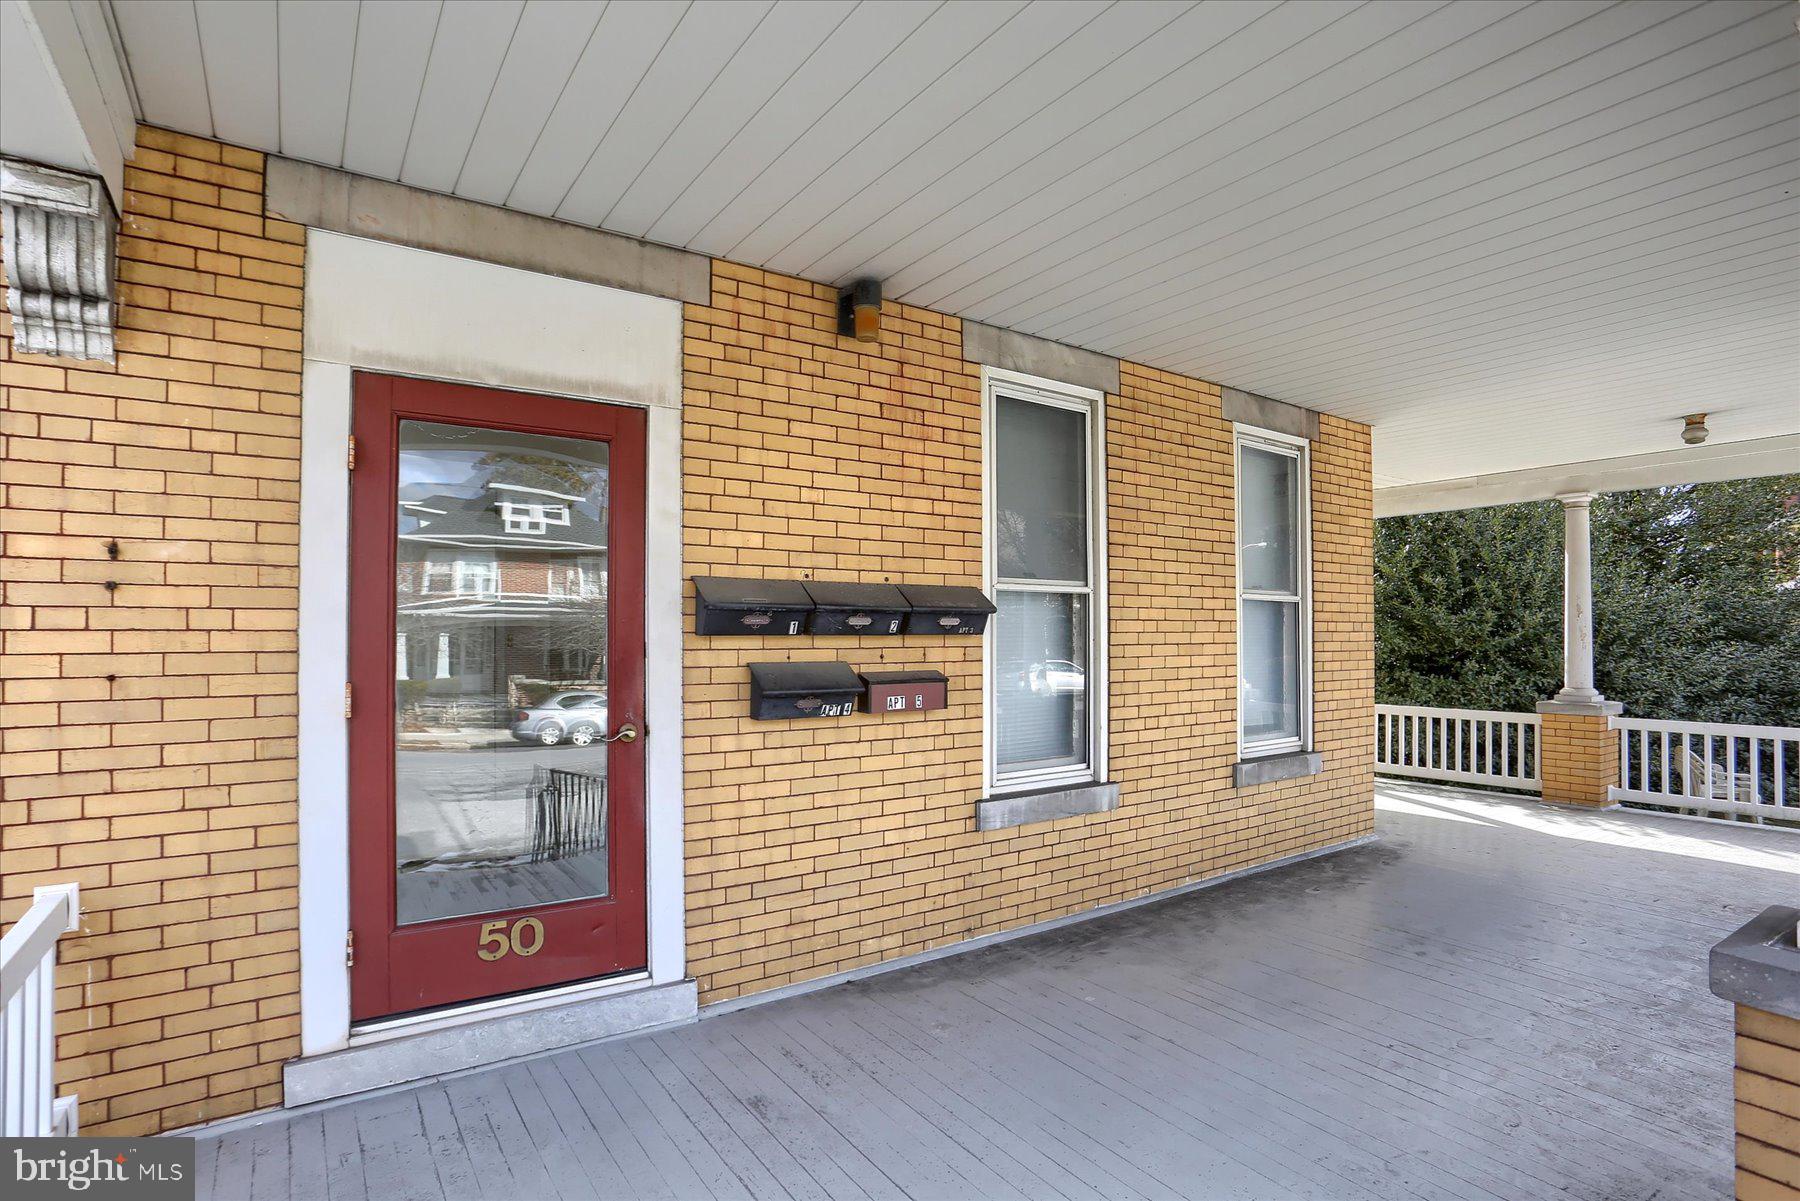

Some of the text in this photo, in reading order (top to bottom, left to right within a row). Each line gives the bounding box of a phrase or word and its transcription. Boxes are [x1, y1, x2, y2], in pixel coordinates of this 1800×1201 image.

[789, 621, 798, 634] 1
[889, 620, 898, 633] 2
[888, 695, 922, 709] APT 5
[843, 703, 852, 715] 4
[477, 916, 544, 961] 50
